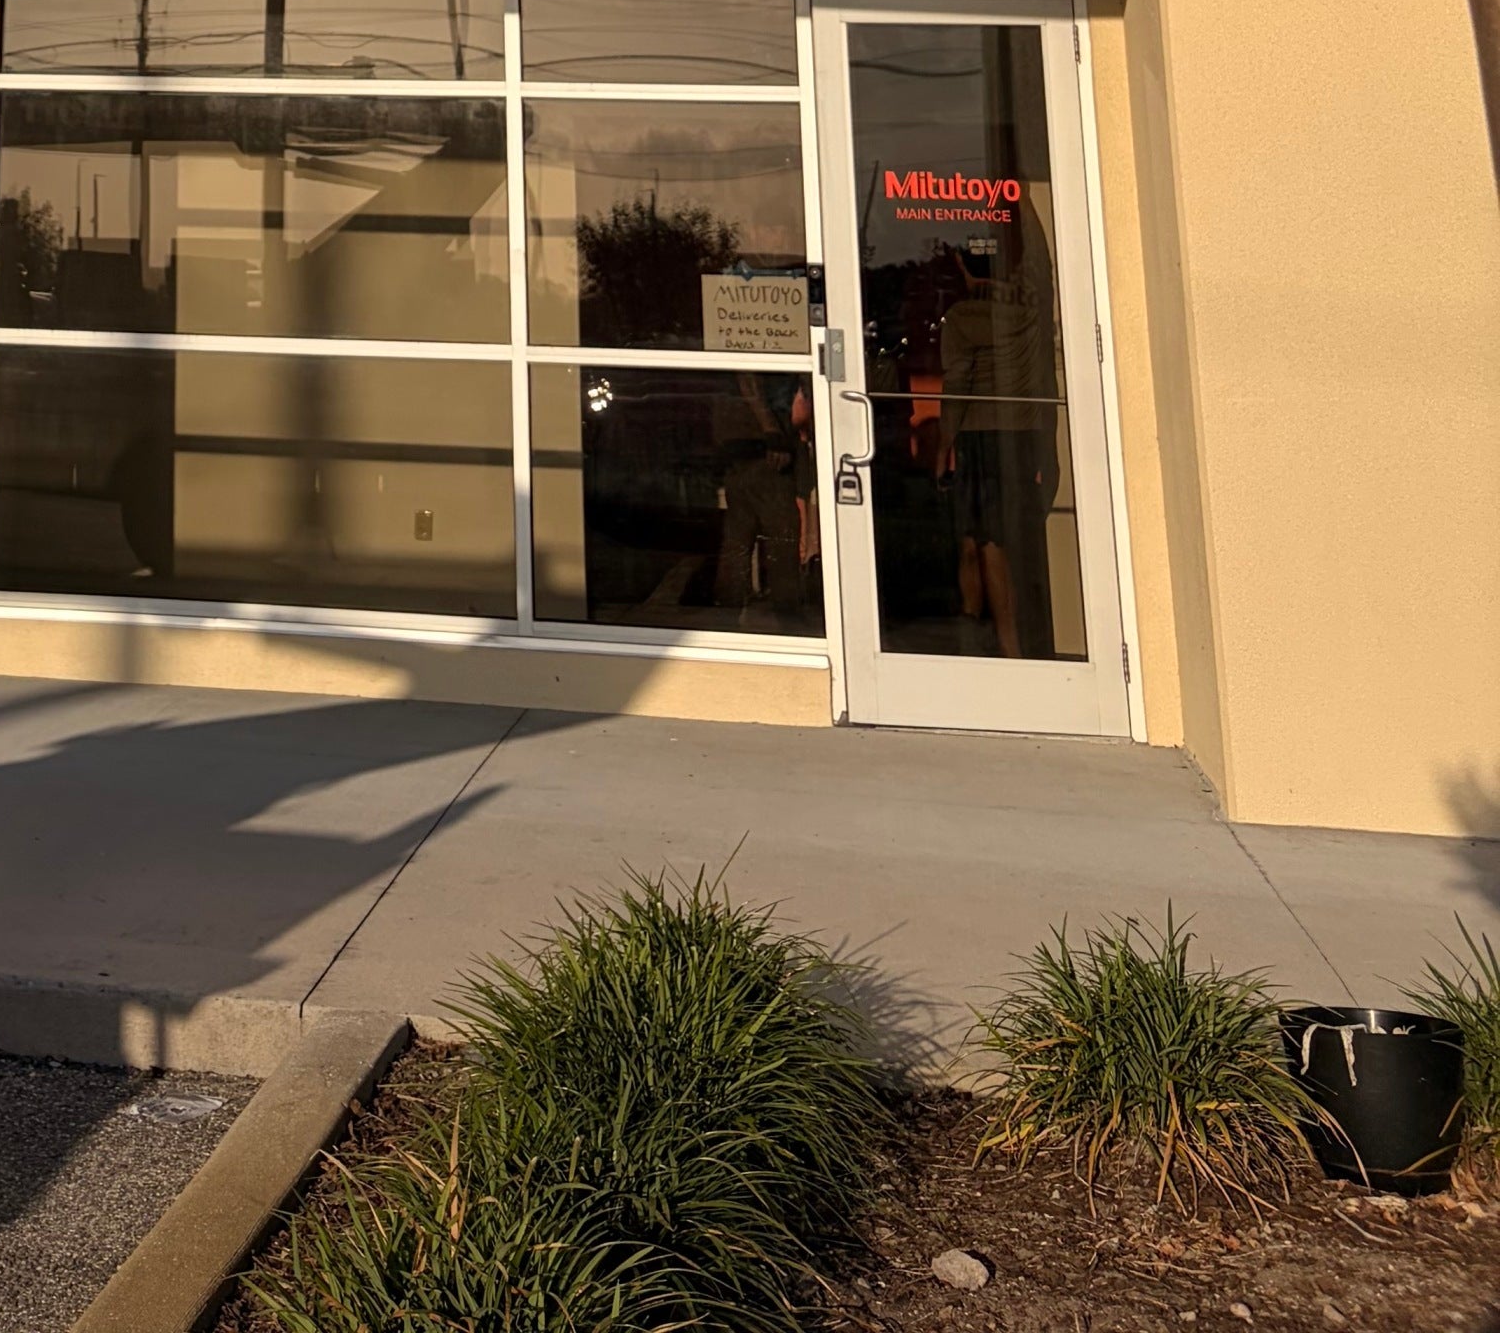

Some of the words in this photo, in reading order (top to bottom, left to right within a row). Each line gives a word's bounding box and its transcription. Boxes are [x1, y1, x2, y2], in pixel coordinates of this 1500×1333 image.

[884, 170, 1021, 208] Mitutoyo
[896, 208, 931, 220] MAIN
[935, 208, 1012, 222] ENTRANCE
[713, 285, 802, 306] MITUTOYO
[717, 307, 790, 323] Deliveries
[718, 326, 733, 337] to
[738, 327, 761, 337] the
